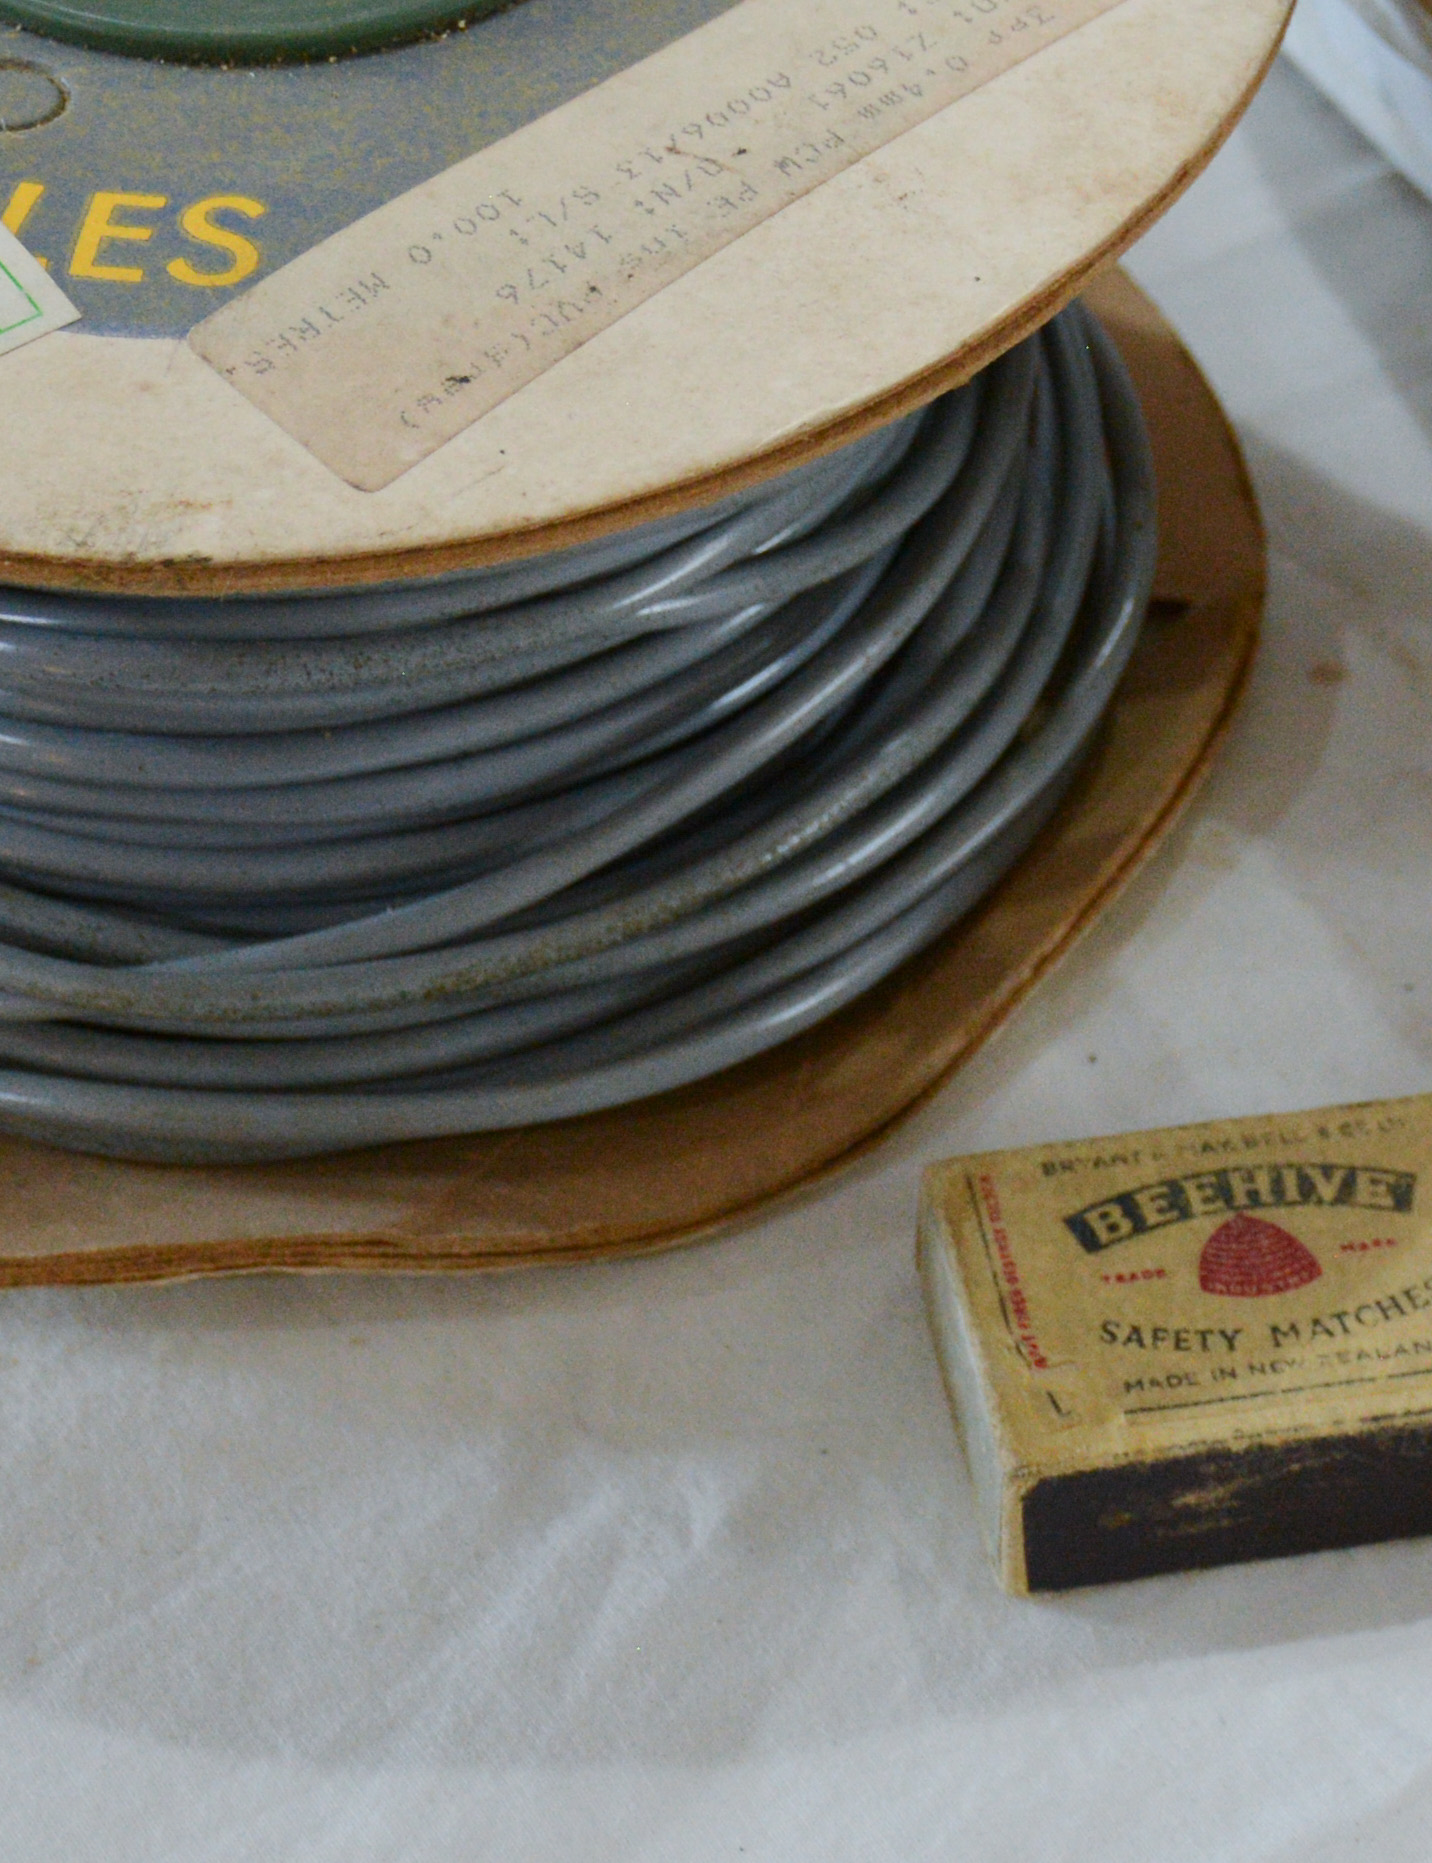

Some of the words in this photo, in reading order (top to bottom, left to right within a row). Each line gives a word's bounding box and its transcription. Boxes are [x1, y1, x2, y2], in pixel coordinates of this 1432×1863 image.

[403, 189, 523, 266] 100.0
[1082, 1163, 1390, 1245] BEEHIVE
[1100, 1319, 1241, 1352] SAFETY
[1123, 1371, 1199, 1395] MADE
[1211, 1366, 1238, 1383] IN
[1248, 1358, 1305, 1376] NEW
